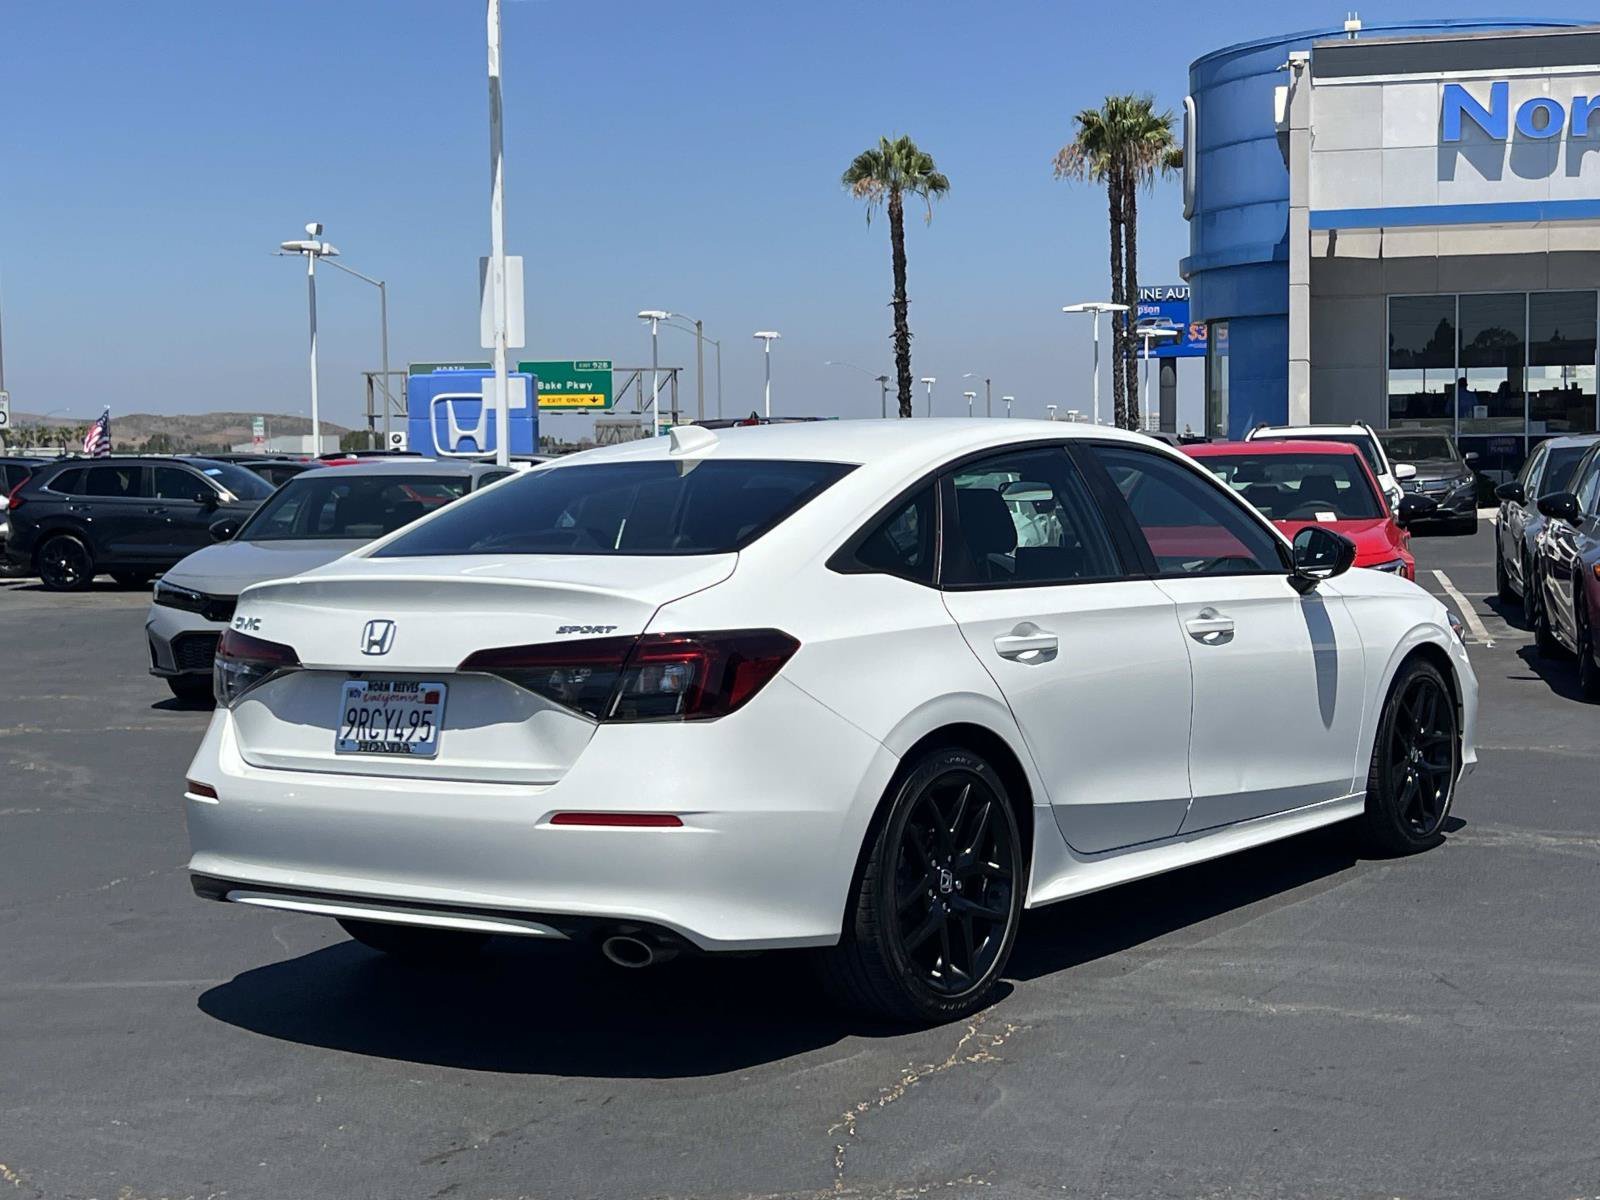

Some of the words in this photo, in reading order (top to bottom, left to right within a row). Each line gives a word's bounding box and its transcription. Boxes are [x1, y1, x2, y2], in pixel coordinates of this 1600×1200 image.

[1137, 288, 1162, 299] INE
[538, 381, 562, 390] Bake
[566, 381, 593, 391] Pkwy
[555, 625, 618, 634] SPORT
[344, 708, 433, 742] 9RCY495
[359, 741, 411, 753] HONDA
